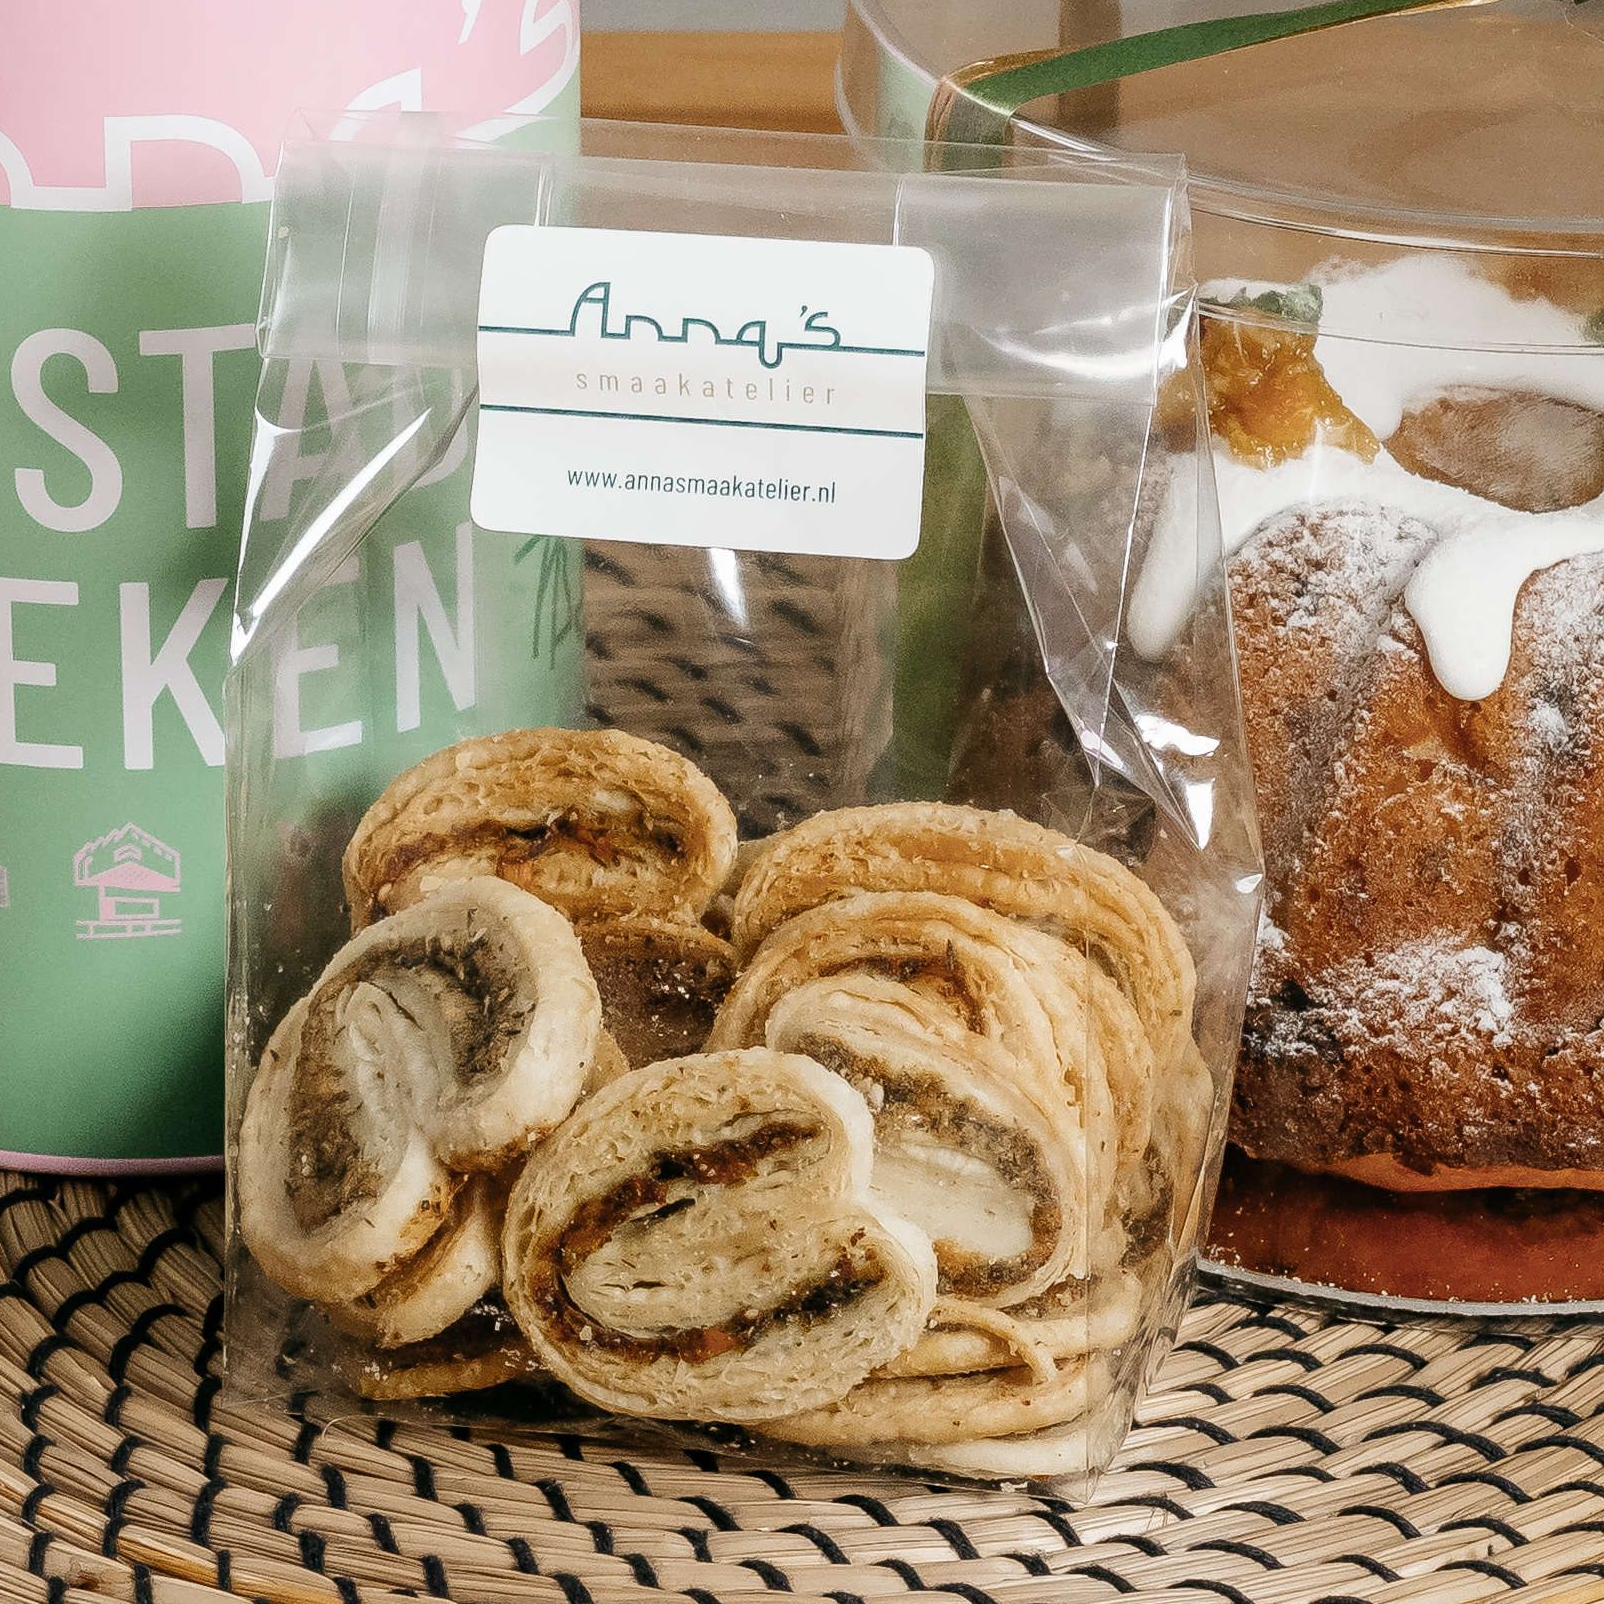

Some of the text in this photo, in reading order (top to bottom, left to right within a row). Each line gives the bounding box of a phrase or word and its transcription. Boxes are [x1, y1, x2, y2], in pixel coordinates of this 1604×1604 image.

[570, 282, 841, 369] Anna's
[576, 371, 837, 405] smaakatelier
[567, 468, 837, 504] www.annasmaakatelier.nl
